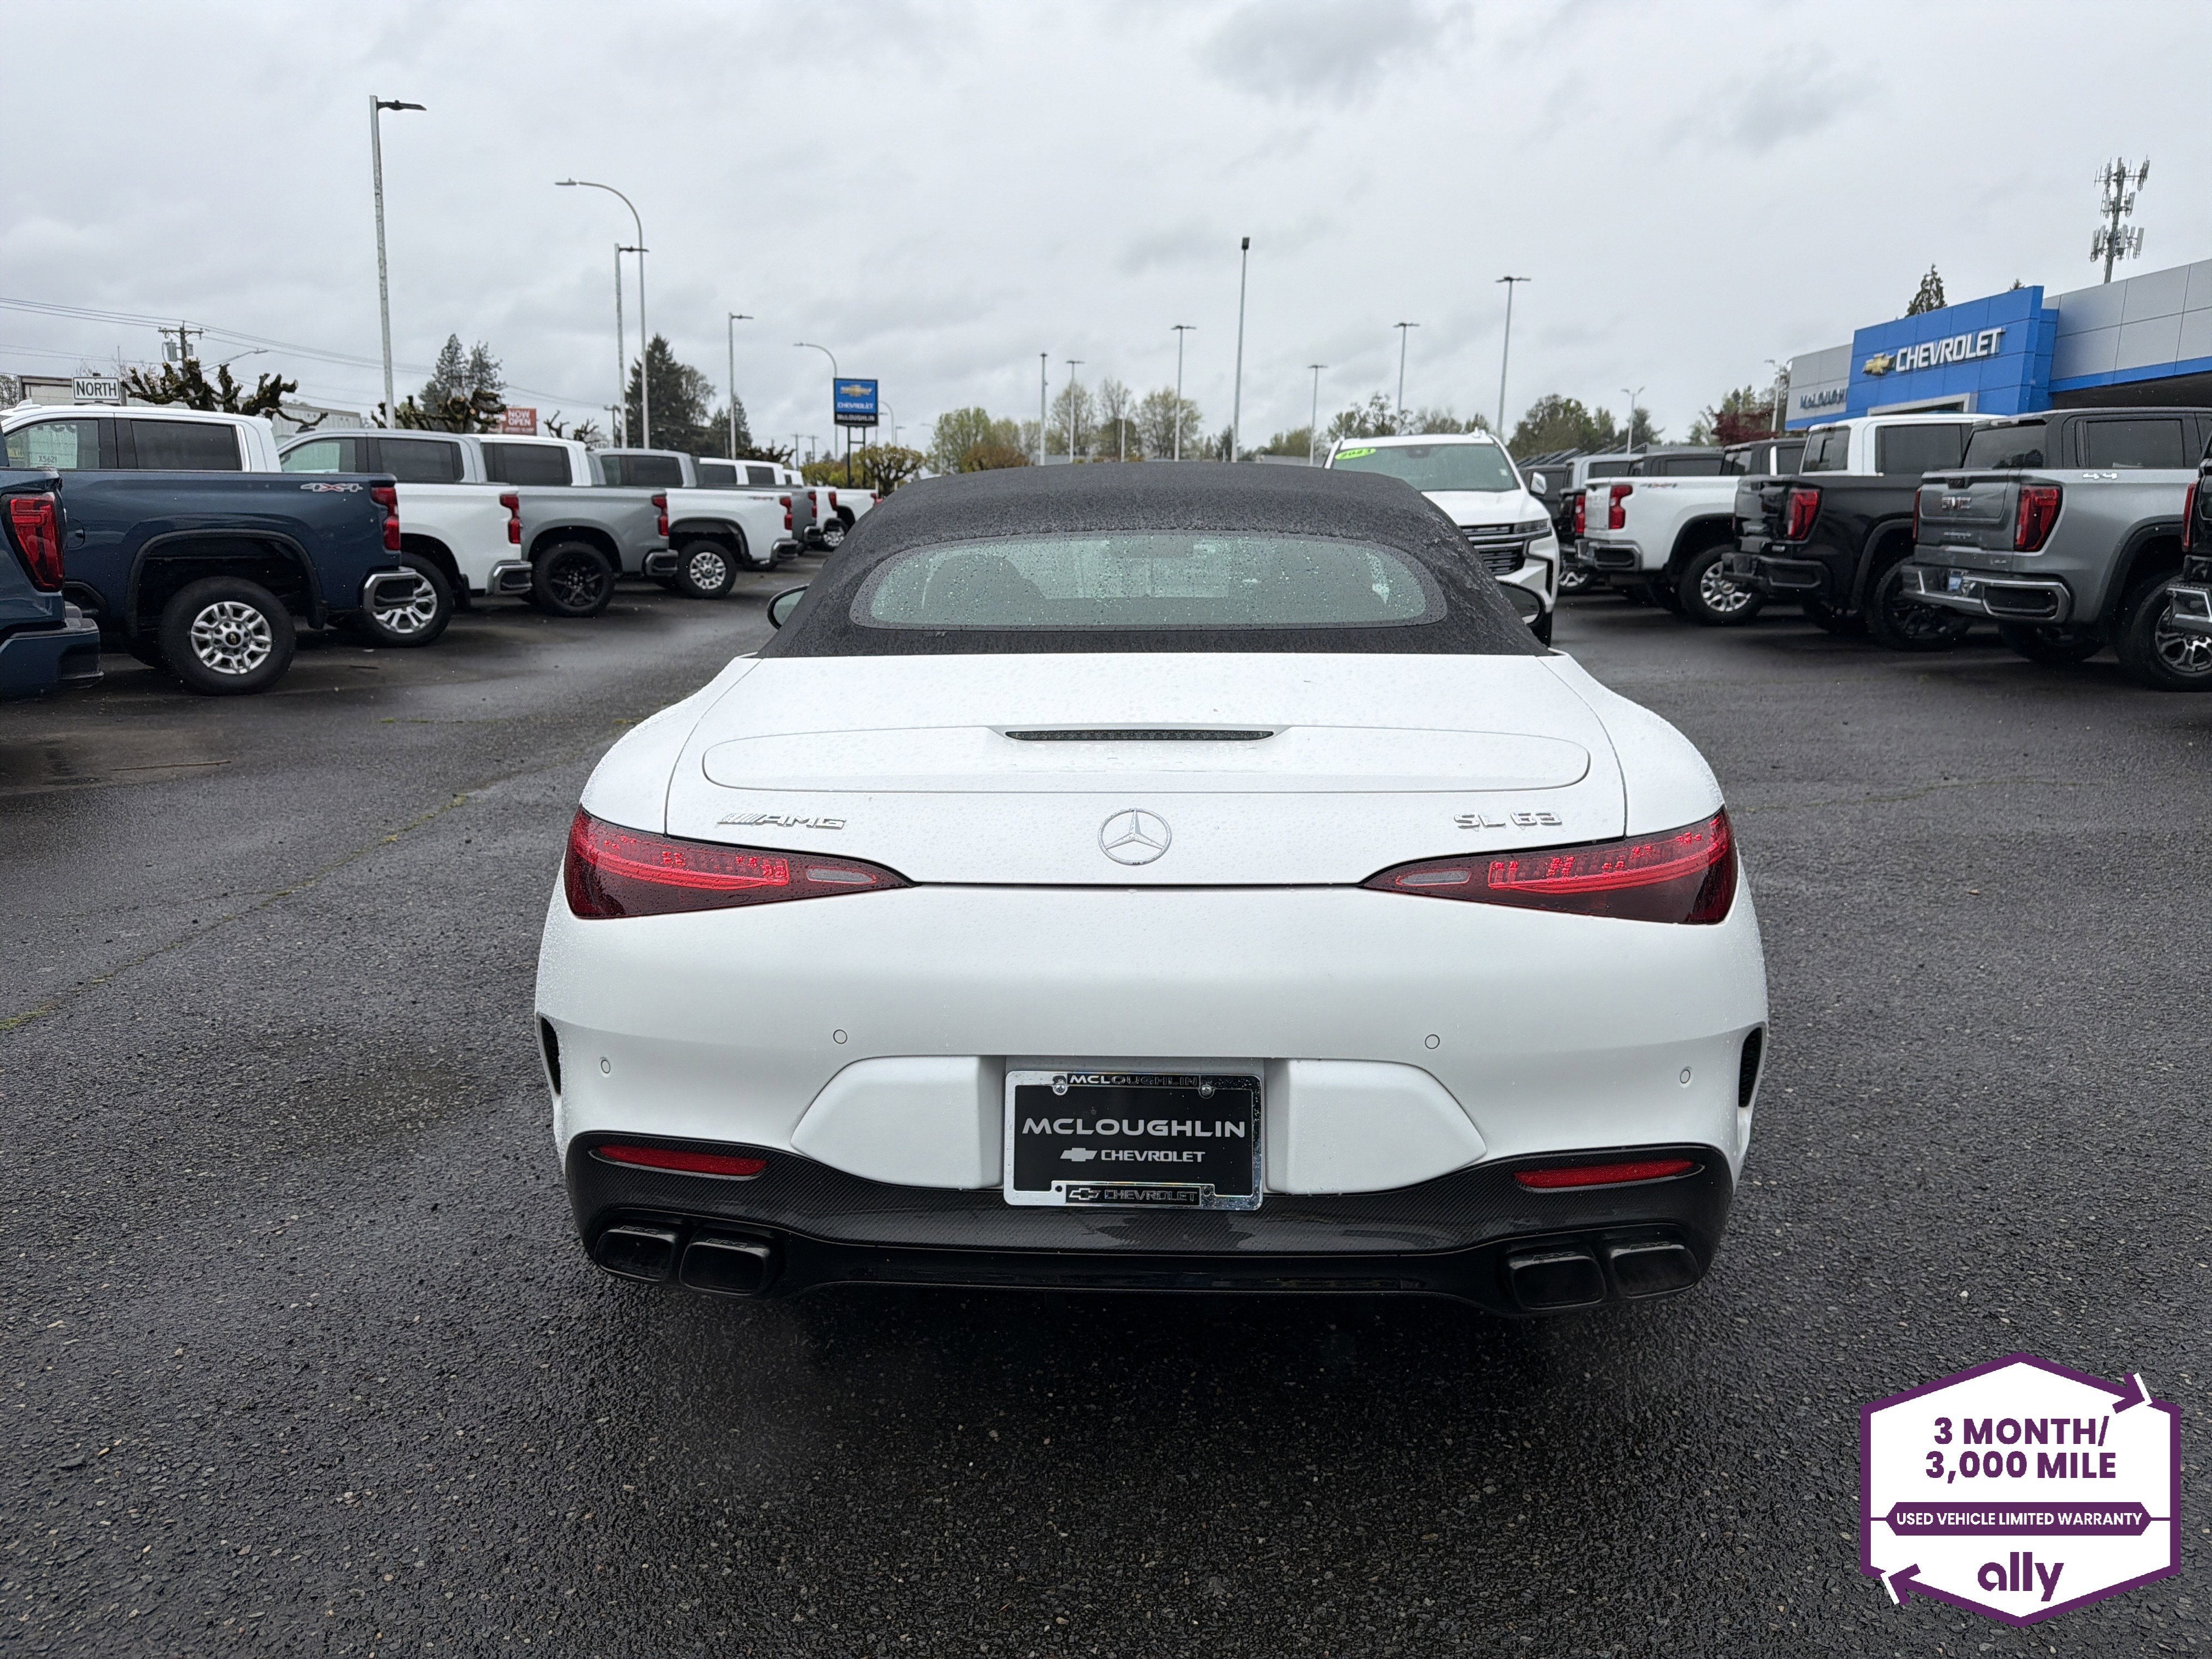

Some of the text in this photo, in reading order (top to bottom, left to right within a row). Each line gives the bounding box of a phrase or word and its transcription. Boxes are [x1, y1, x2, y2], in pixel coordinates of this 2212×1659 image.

[1895, 327, 2004, 373] CHEVROLET
[76, 381, 117, 396] NORTH
[508, 410, 531, 419] NOW
[508, 417, 532, 426] OPEN
[1454, 812, 1562, 829] SL 63
[1069, 1075, 1198, 1087] MCLOUGHLIN
[1022, 1118, 1245, 1138] MCLOUGHLIN
[1101, 1149, 1206, 1163] CHEVROLET
[1104, 1189, 1198, 1201] CHEVROLET
